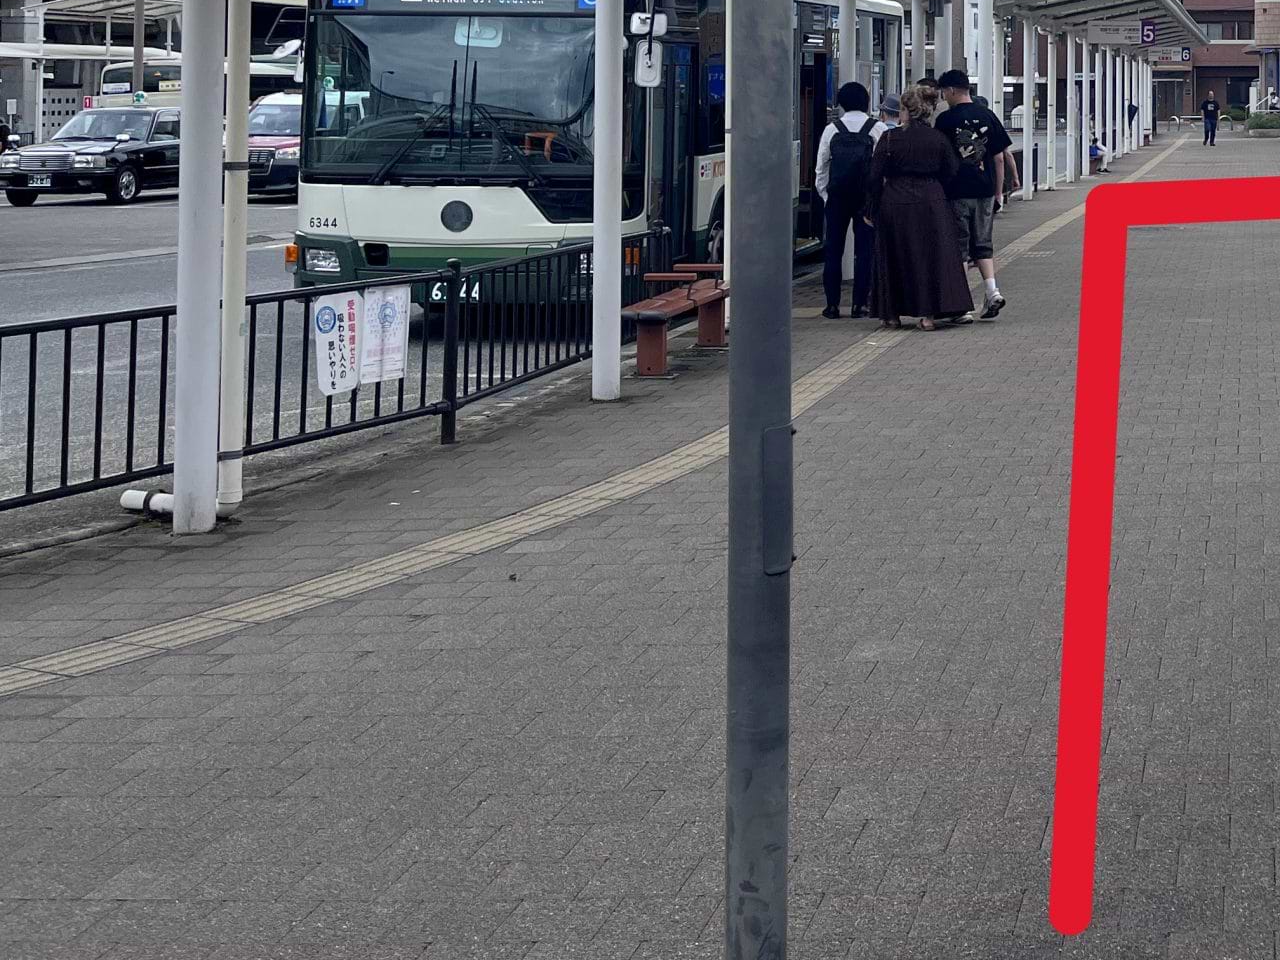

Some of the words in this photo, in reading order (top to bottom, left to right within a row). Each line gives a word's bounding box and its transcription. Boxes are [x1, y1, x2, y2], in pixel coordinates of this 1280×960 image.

[1143, 25, 1154, 42] 5
[1182, 49, 1190, 60] 6
[309, 217, 338, 228] 6344
[432, 282, 480, 301] 644
[337, 313, 347, 379] 吸わない人への
[328, 340, 337, 390] 思いやりを
